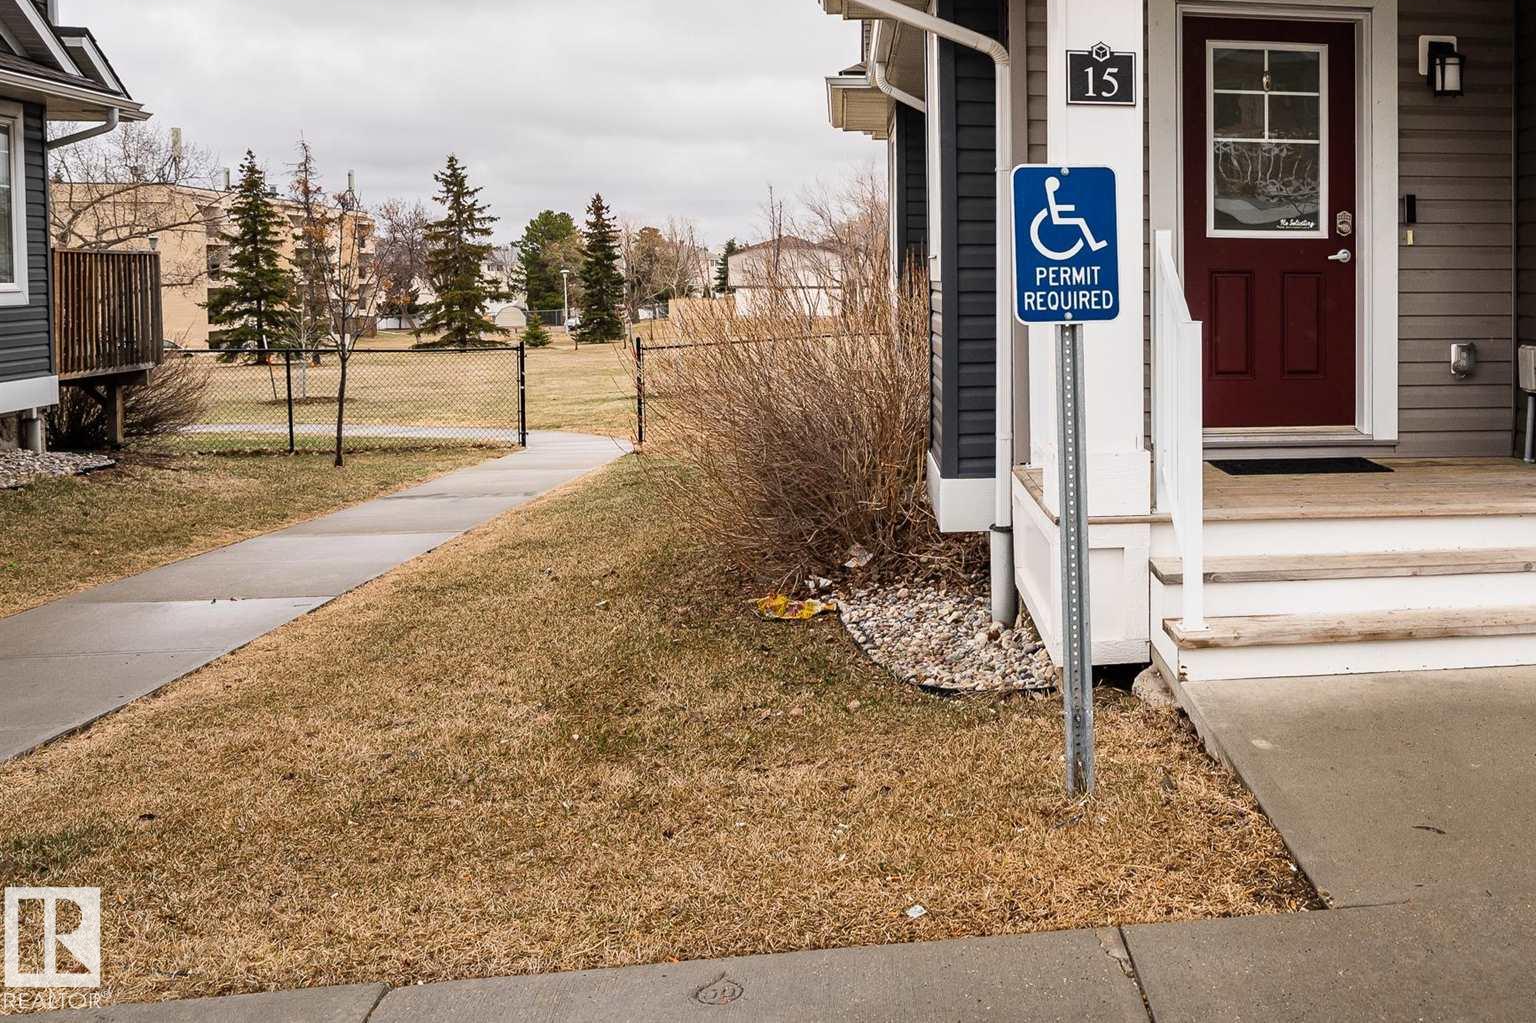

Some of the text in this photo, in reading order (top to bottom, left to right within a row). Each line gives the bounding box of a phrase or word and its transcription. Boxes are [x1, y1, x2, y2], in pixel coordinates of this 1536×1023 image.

[1083, 66, 1119, 97] 15
[1035, 266, 1101, 286] PERMIT
[1024, 290, 1113, 311] REQUIRED
